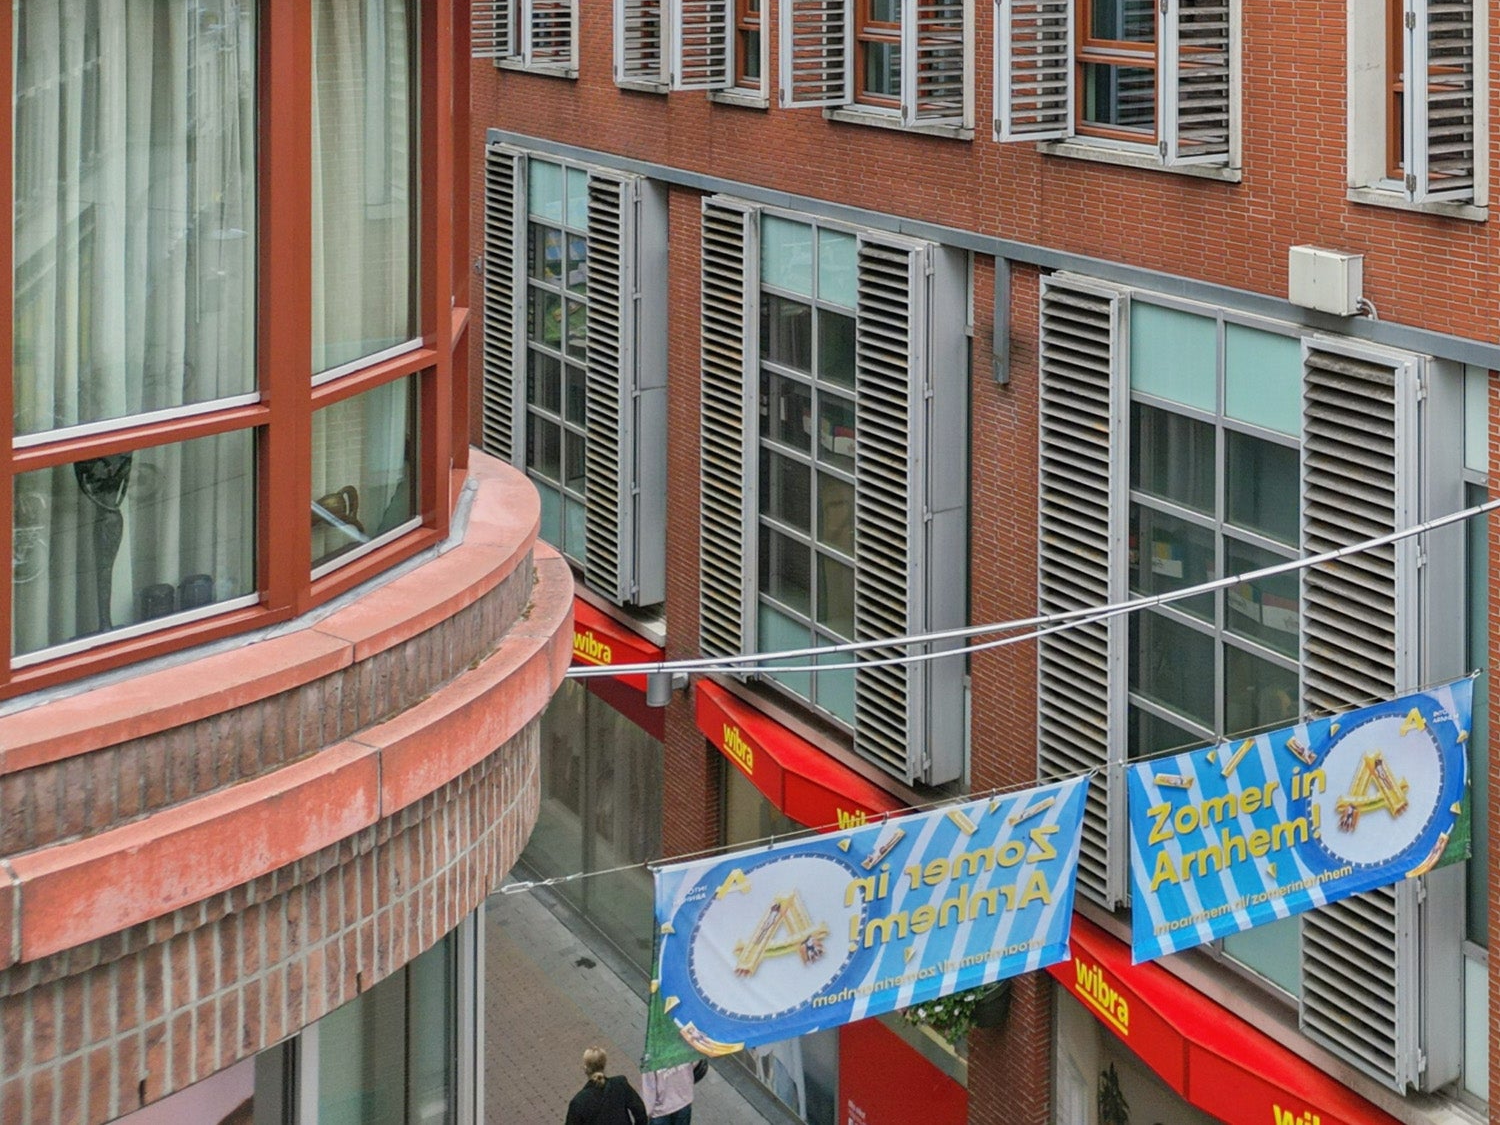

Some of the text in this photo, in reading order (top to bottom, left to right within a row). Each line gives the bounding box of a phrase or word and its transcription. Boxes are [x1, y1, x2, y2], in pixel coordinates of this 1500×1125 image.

[573, 630, 612, 665] wibra
[723, 723, 754, 770] wibra
[1146, 766, 1327, 846] Zomer in
[1150, 803, 1322, 892] Arnhem!
[1075, 957, 1129, 1026] wibra
